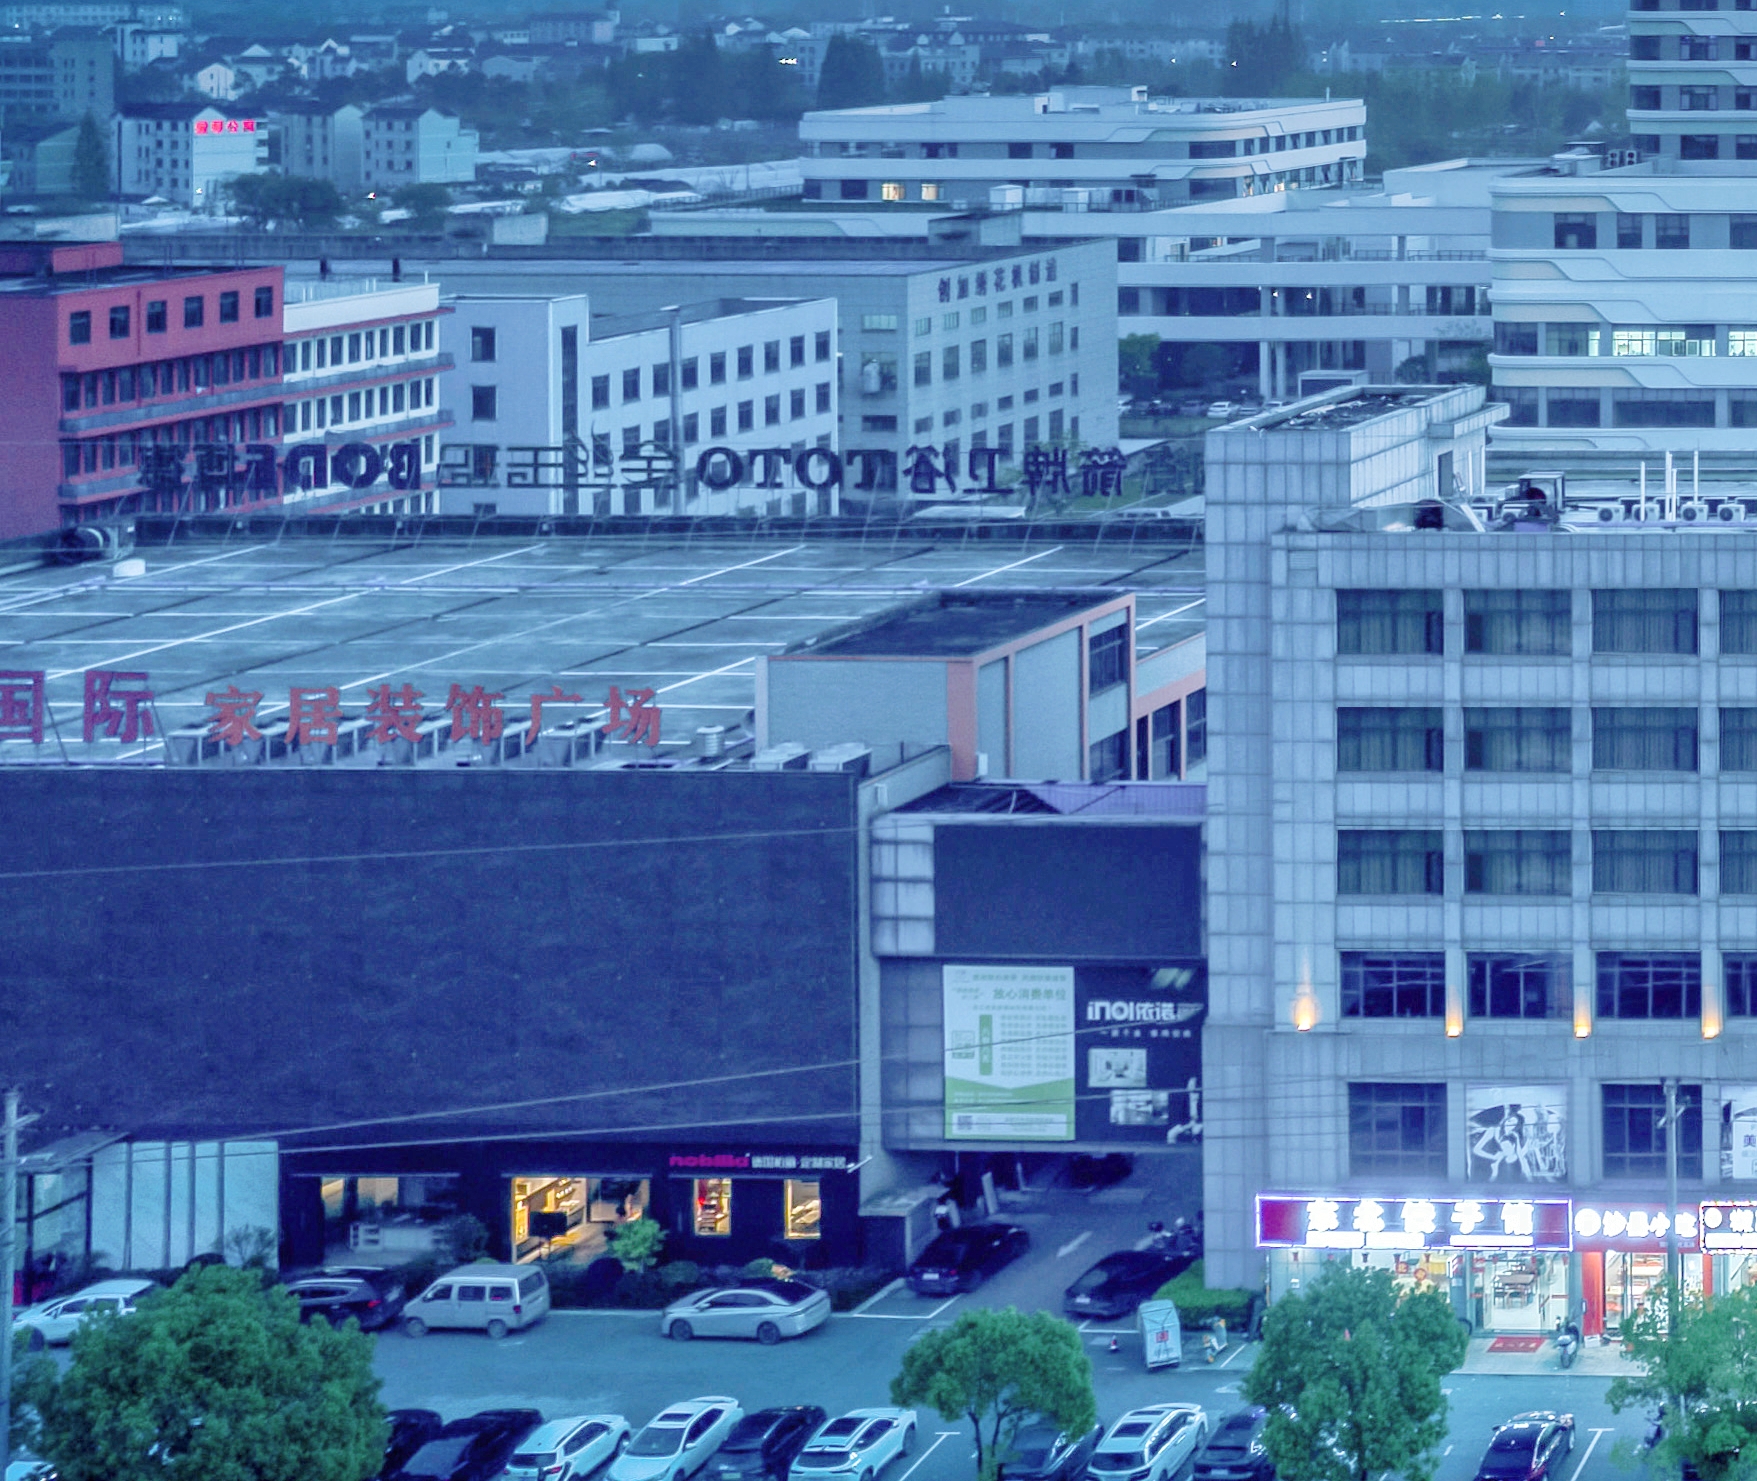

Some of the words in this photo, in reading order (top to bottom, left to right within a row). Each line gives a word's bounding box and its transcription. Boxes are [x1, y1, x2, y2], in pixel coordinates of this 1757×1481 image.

[204, 684, 664, 746] 家居装饰广场
